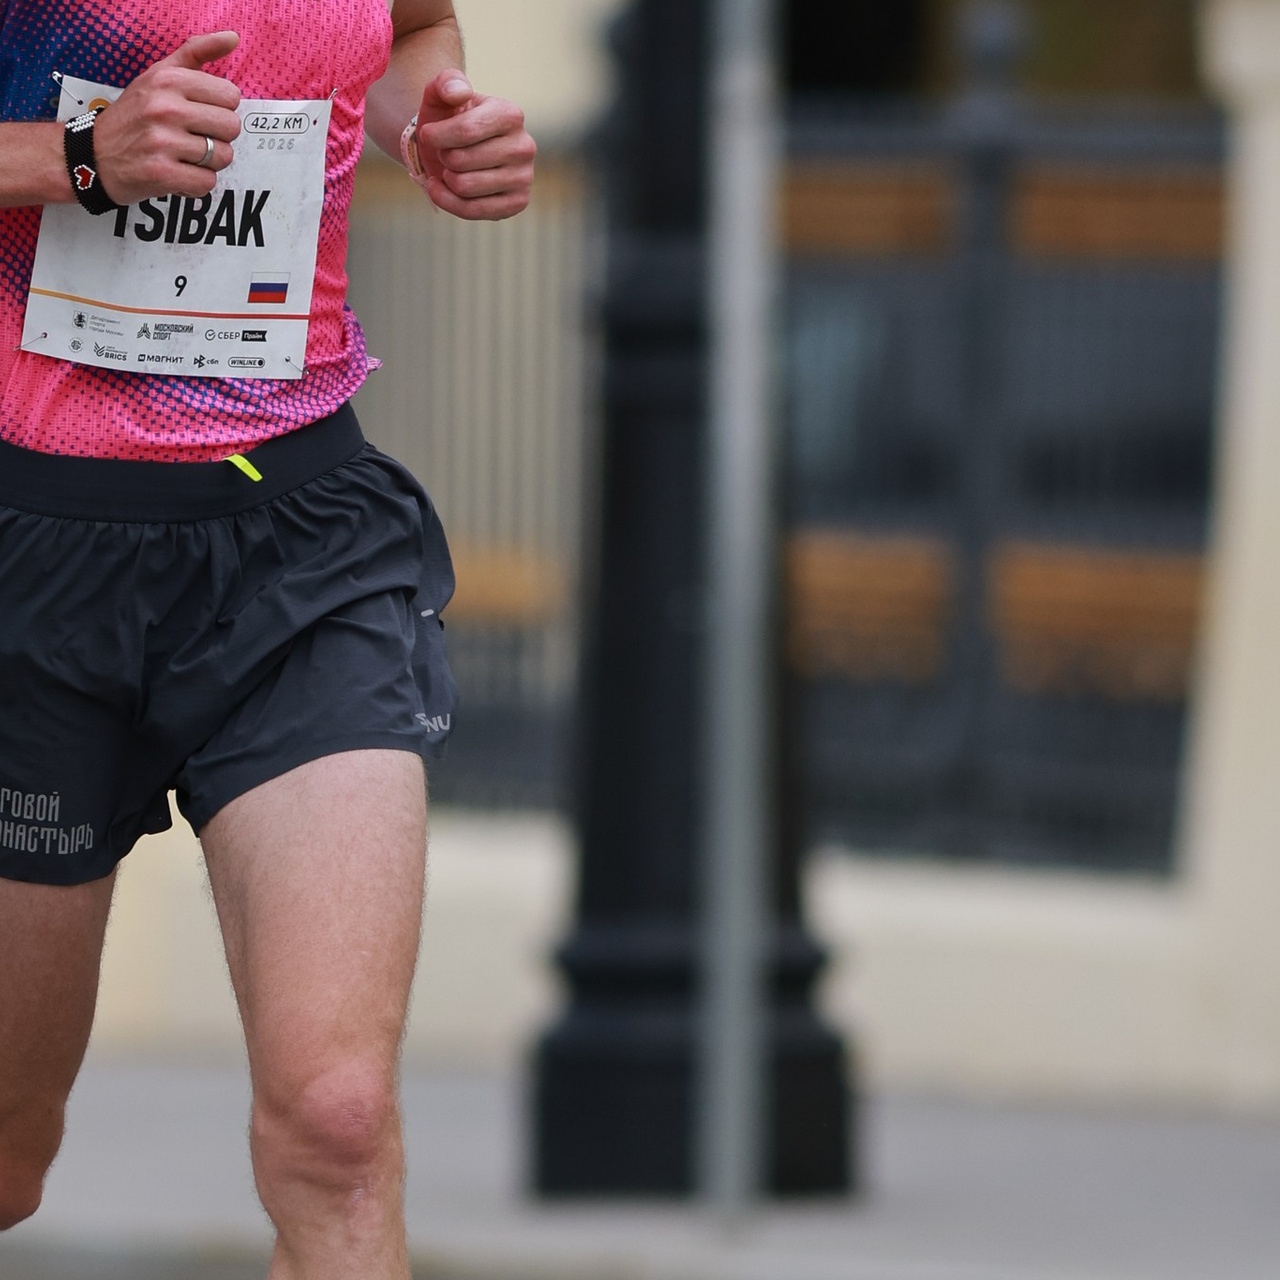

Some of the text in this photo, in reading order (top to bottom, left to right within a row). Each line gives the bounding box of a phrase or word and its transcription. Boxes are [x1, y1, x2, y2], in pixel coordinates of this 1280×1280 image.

[251, 117, 303, 130] 42,2 KM
[257, 137, 295, 150] 2026
[174, 275, 188, 297] 9
[153, 323, 194, 334] МОСКОВСКИЙ
[152, 332, 171, 341] СПОРТ
[217, 331, 263, 340] СБЕР Прайм
[104, 352, 127, 362] BRICS
[146, 355, 184, 364] магнит
[231, 358, 257, 366] WINLINE
[415, 713, 450, 733] SNU
